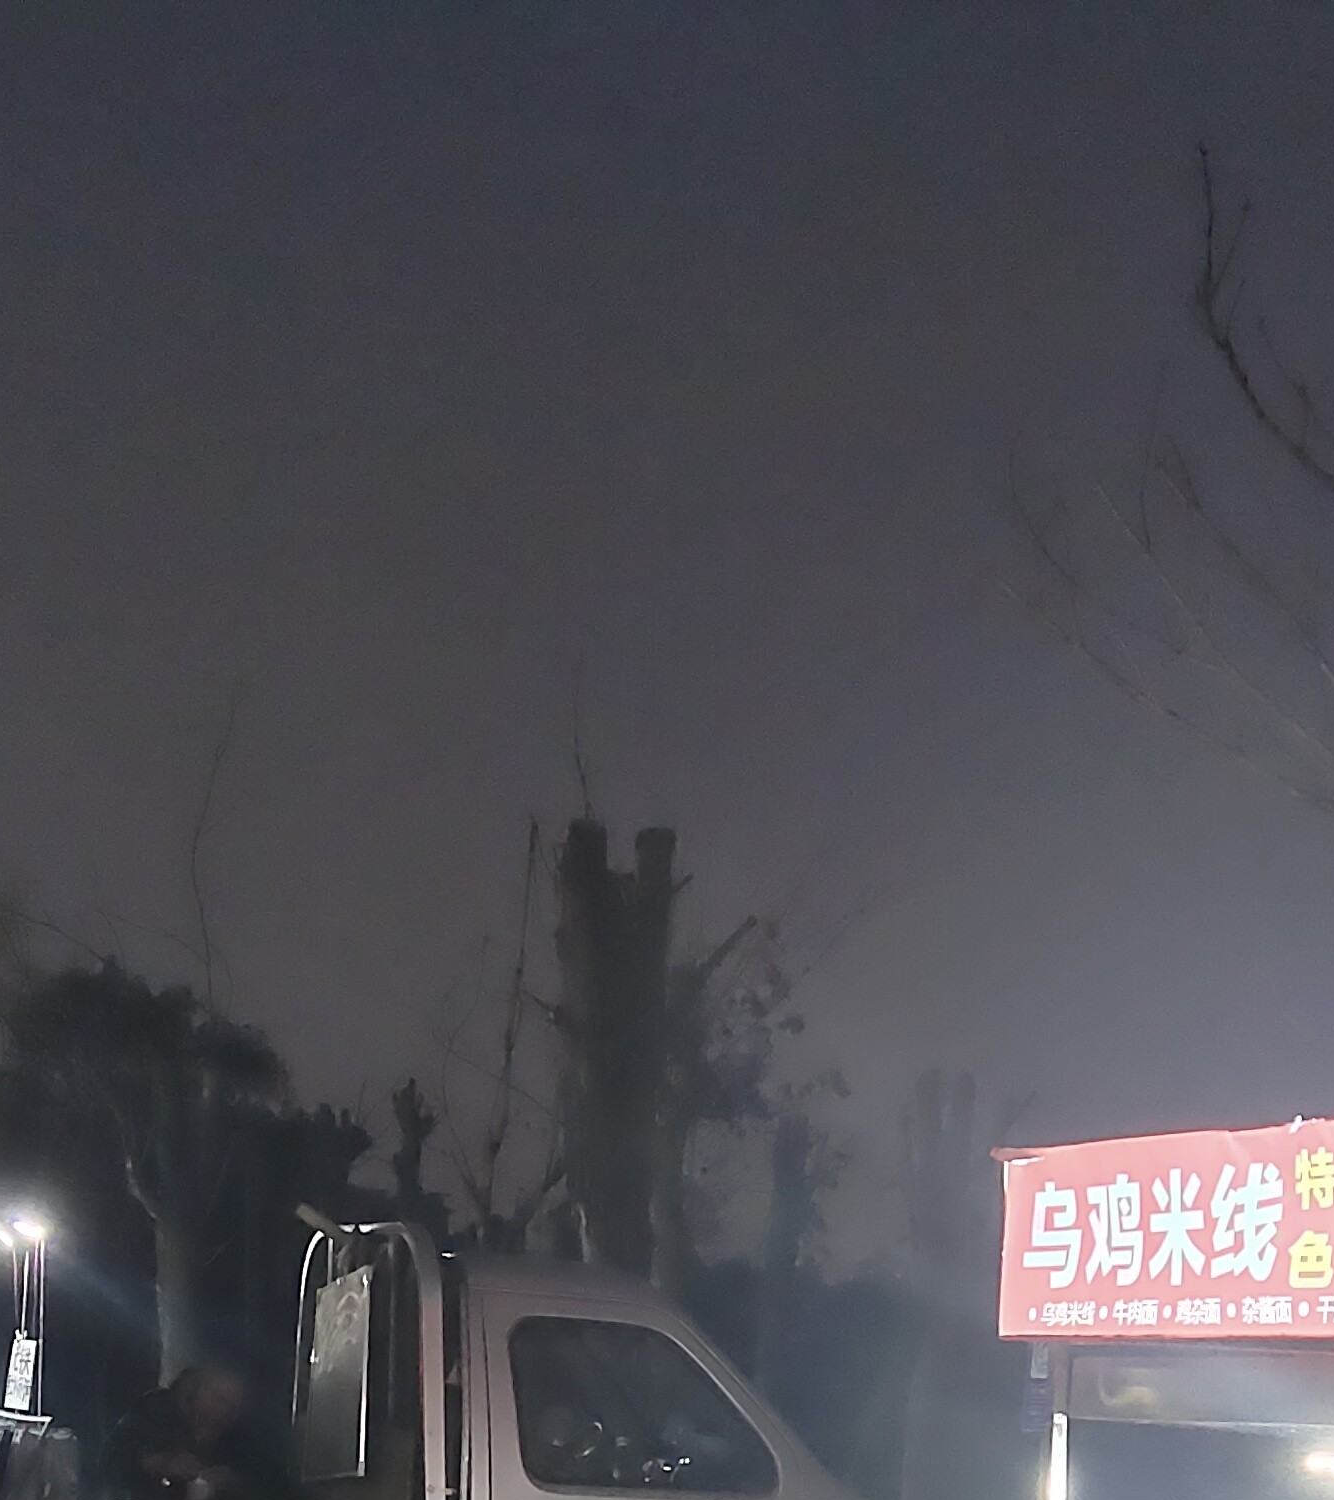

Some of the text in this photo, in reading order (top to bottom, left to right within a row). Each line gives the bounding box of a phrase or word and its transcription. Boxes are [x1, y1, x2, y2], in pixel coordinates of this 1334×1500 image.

[1022, 1161, 1283, 1288] 乌鸡米线
[1112, 1299, 1160, 1325] 牛肉面
